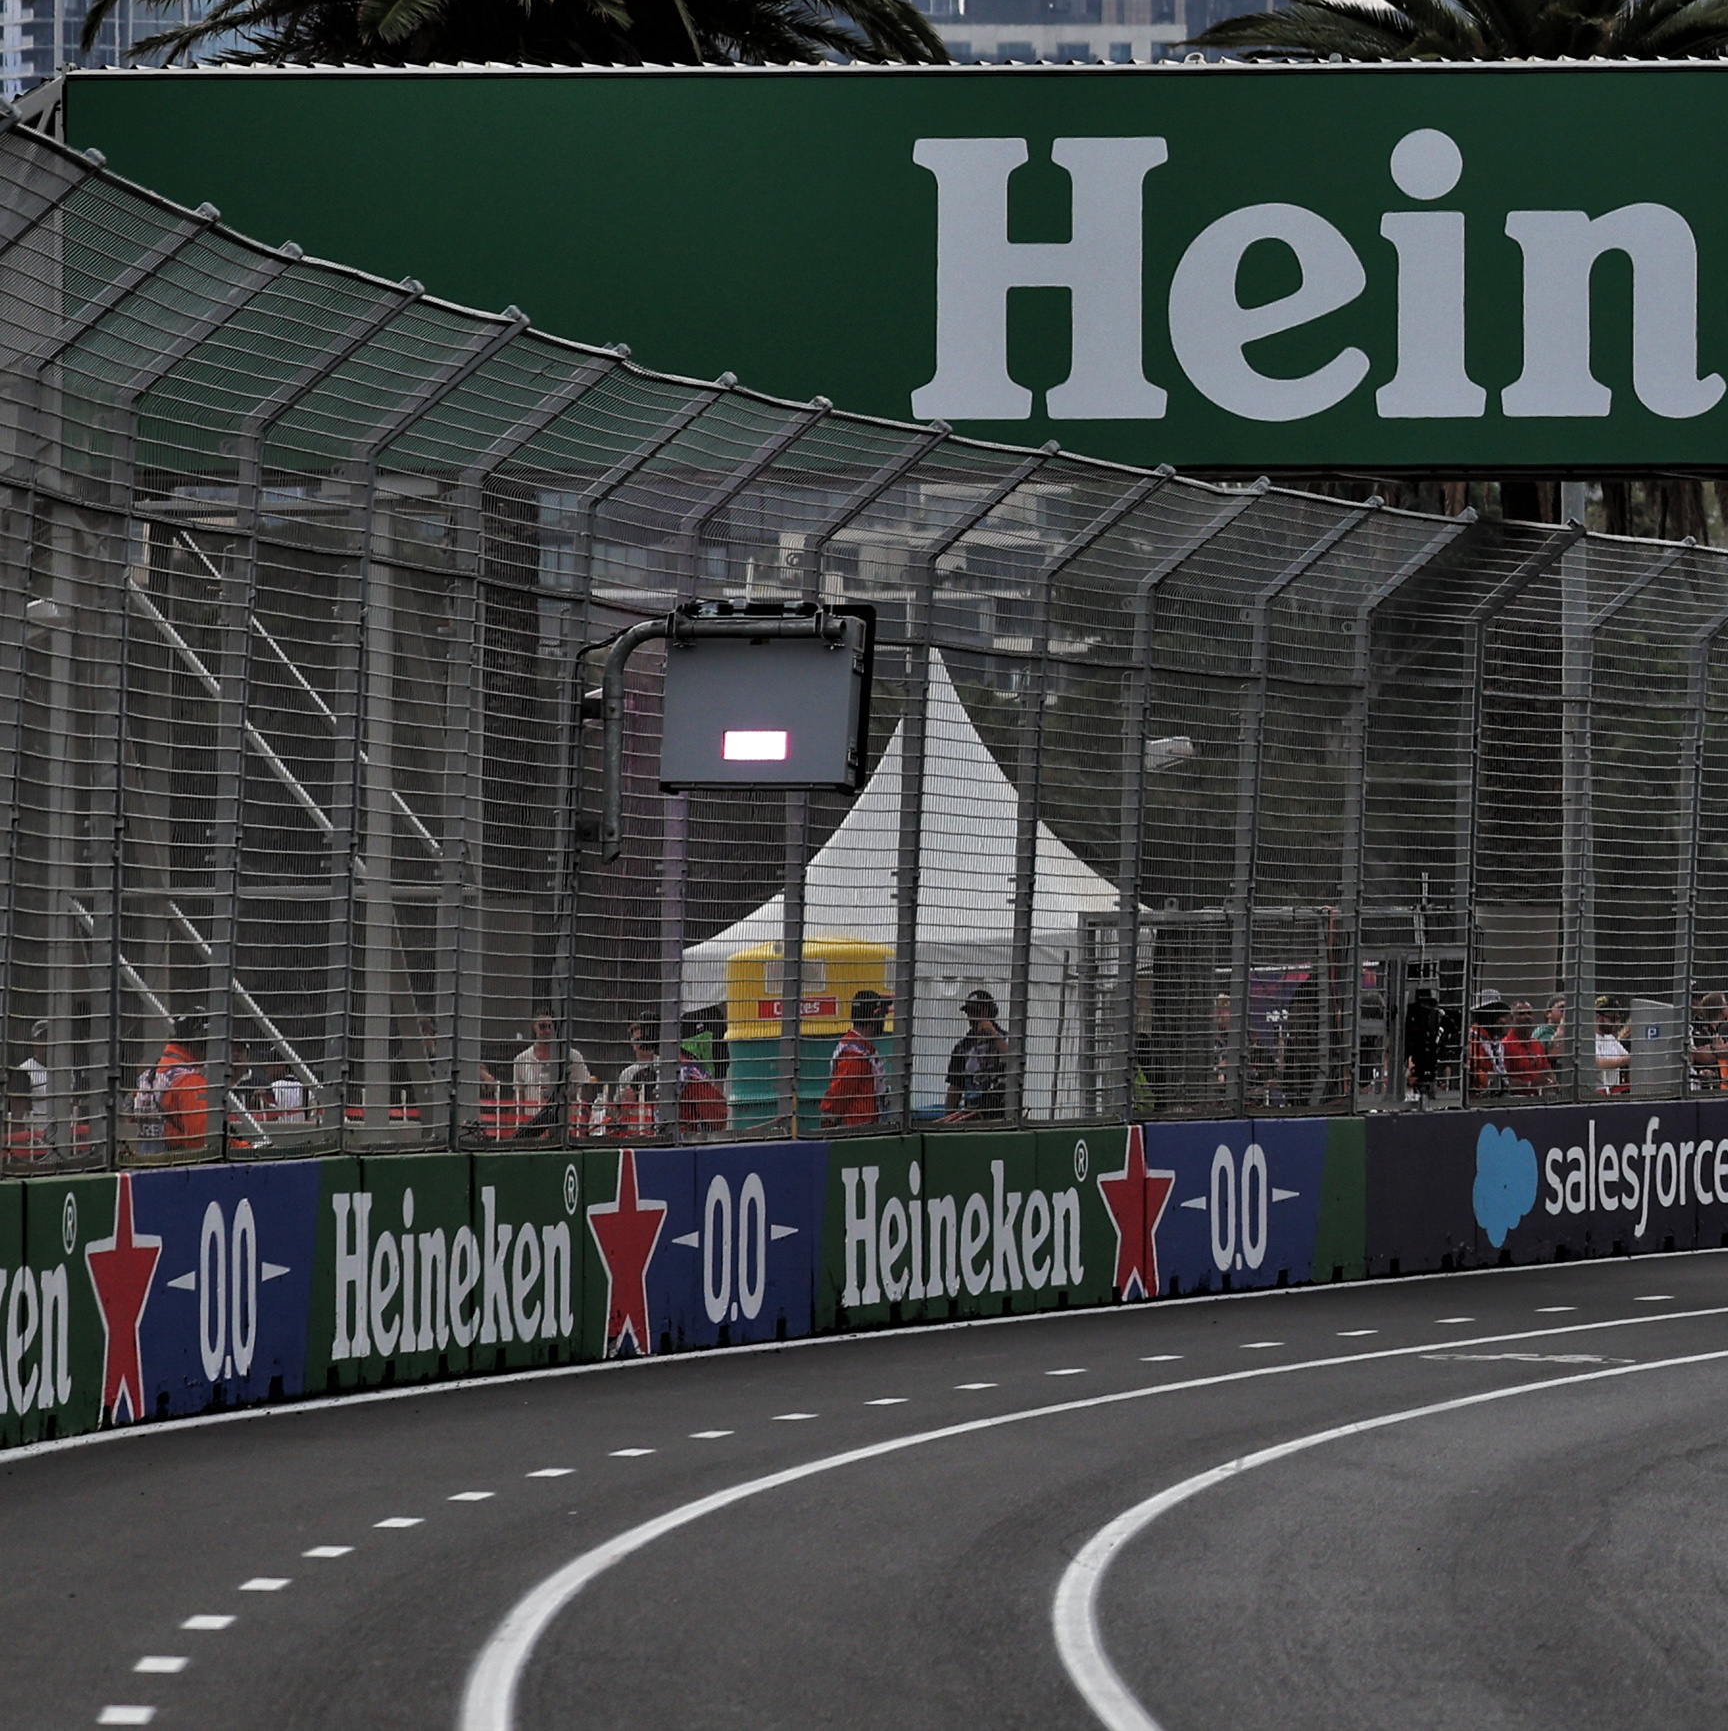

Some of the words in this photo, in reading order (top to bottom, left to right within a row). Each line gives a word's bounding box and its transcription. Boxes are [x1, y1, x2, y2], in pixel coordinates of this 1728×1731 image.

[0, 1263, 72, 1416] en
[200, 1198, 257, 1381] 0.0
[331, 1186, 575, 1360] Heineken
[703, 1173, 766, 1323] 0.0
[841, 1159, 1084, 1307] Heineken
[1210, 1144, 1268, 1271] 0.0
